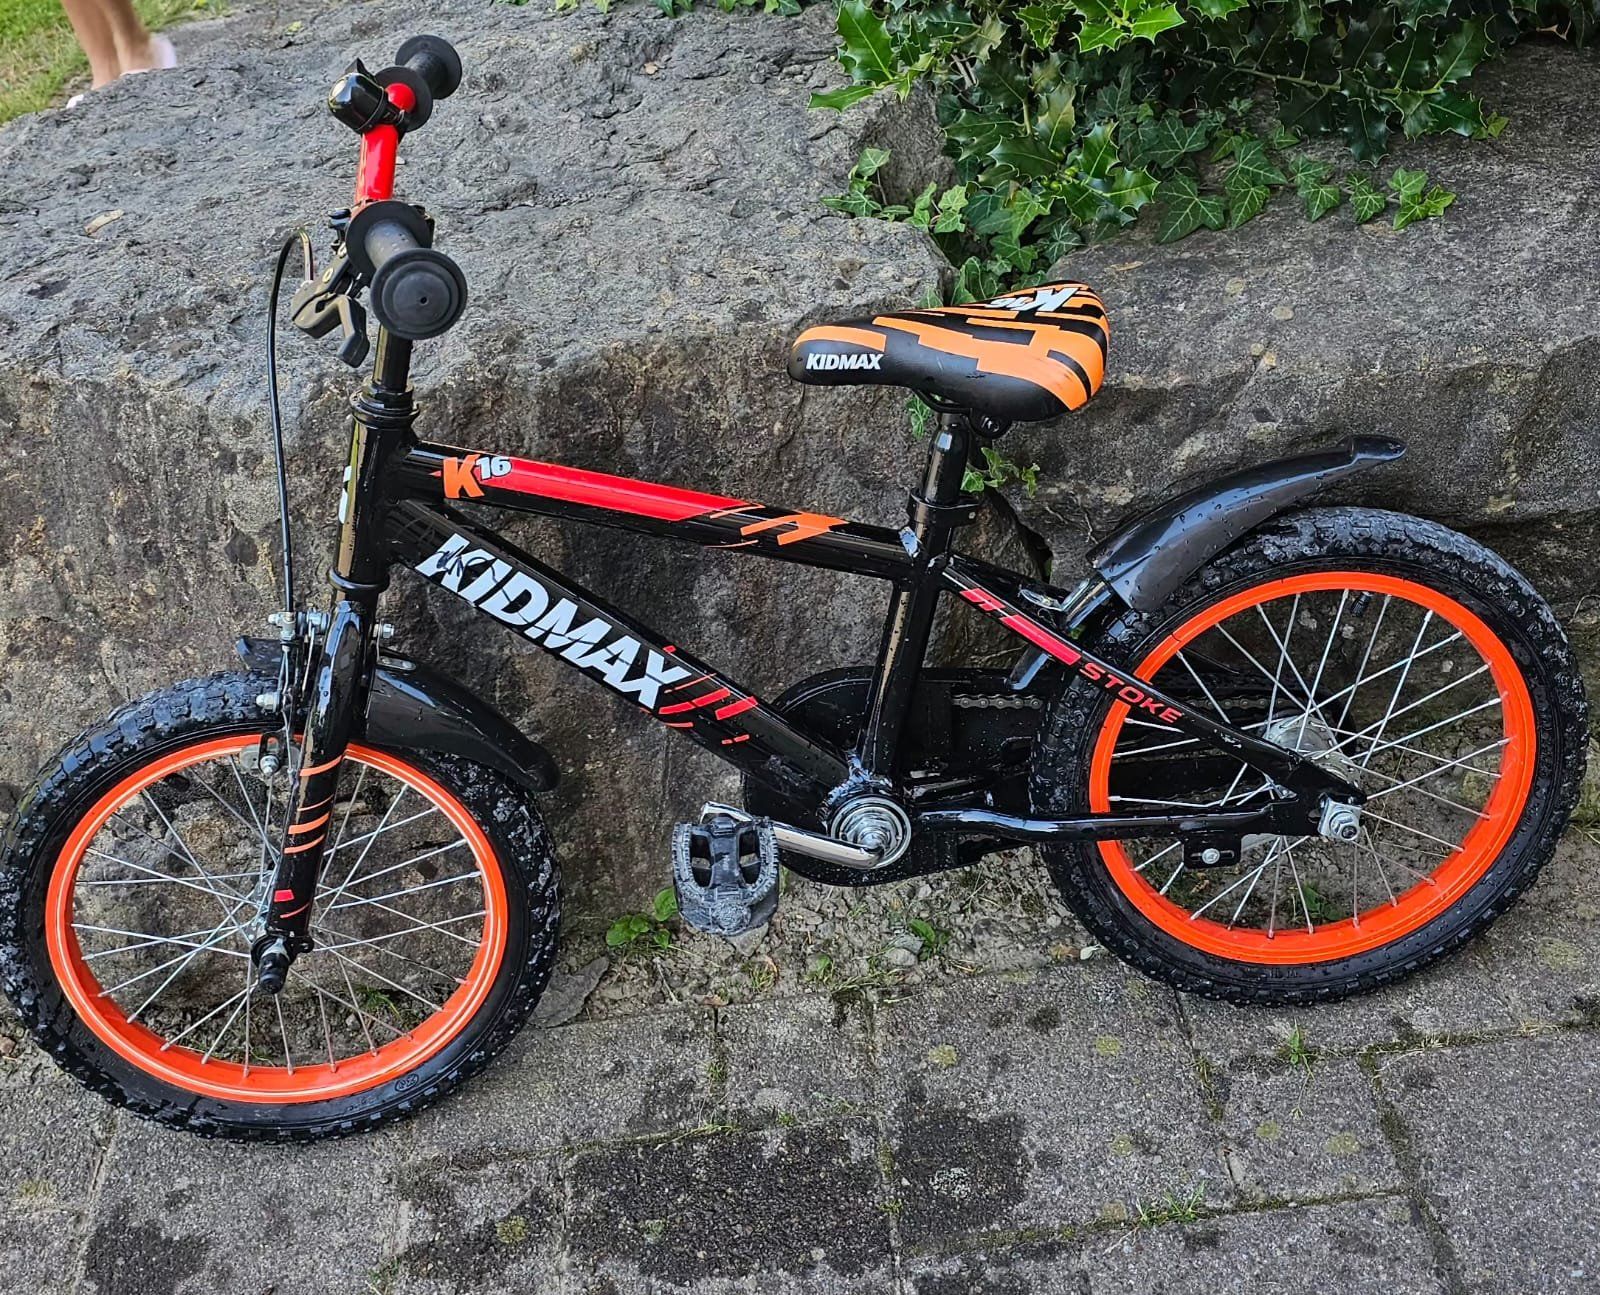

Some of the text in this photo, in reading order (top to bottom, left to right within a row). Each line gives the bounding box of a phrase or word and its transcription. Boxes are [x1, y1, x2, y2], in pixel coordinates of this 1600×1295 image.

[805, 352, 884, 371] KIDMAX
[415, 533, 691, 709] KIDMAX
[1079, 662, 1184, 724] STOKE
